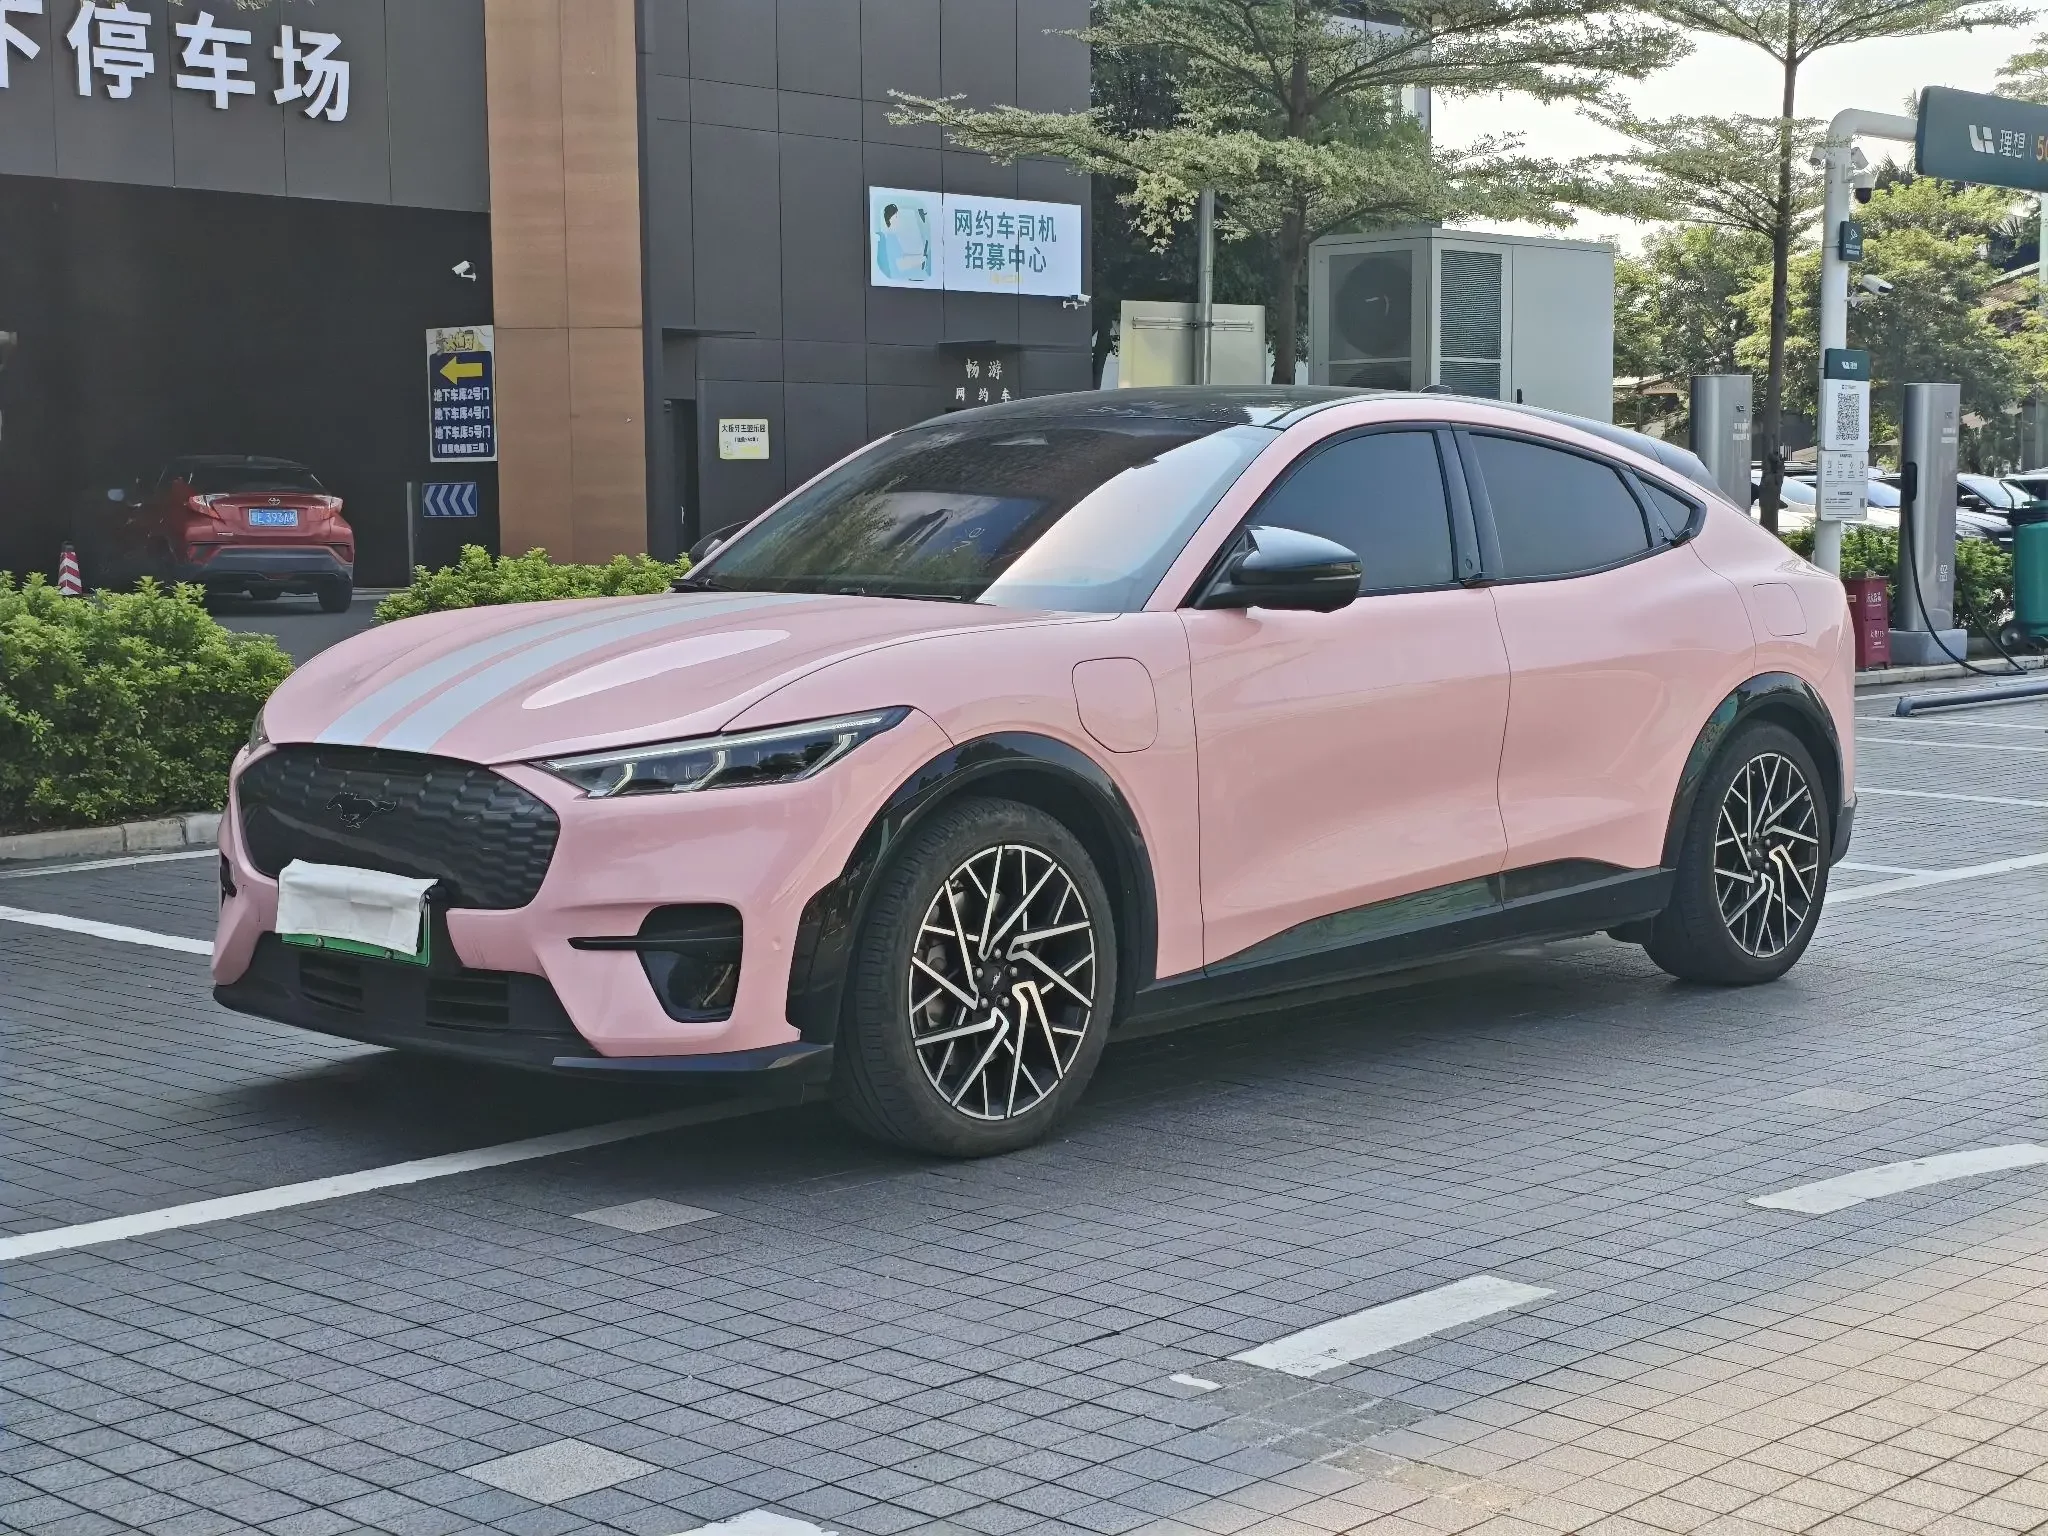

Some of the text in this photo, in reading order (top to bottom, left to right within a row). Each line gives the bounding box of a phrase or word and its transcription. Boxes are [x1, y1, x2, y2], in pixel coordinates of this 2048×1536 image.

[1999, 129, 2026, 159] 理想
[954, 208, 1057, 243] 网约车司机
[964, 240, 1047, 273] 招募中心
[965, 358, 1003, 380] 畅游
[433, 386, 490, 402] 地下车库2号门
[955, 386, 1012, 404] 网约车
[434, 405, 490, 421] 地下车库4号门
[435, 424, 491, 440] 地下车库5号门
